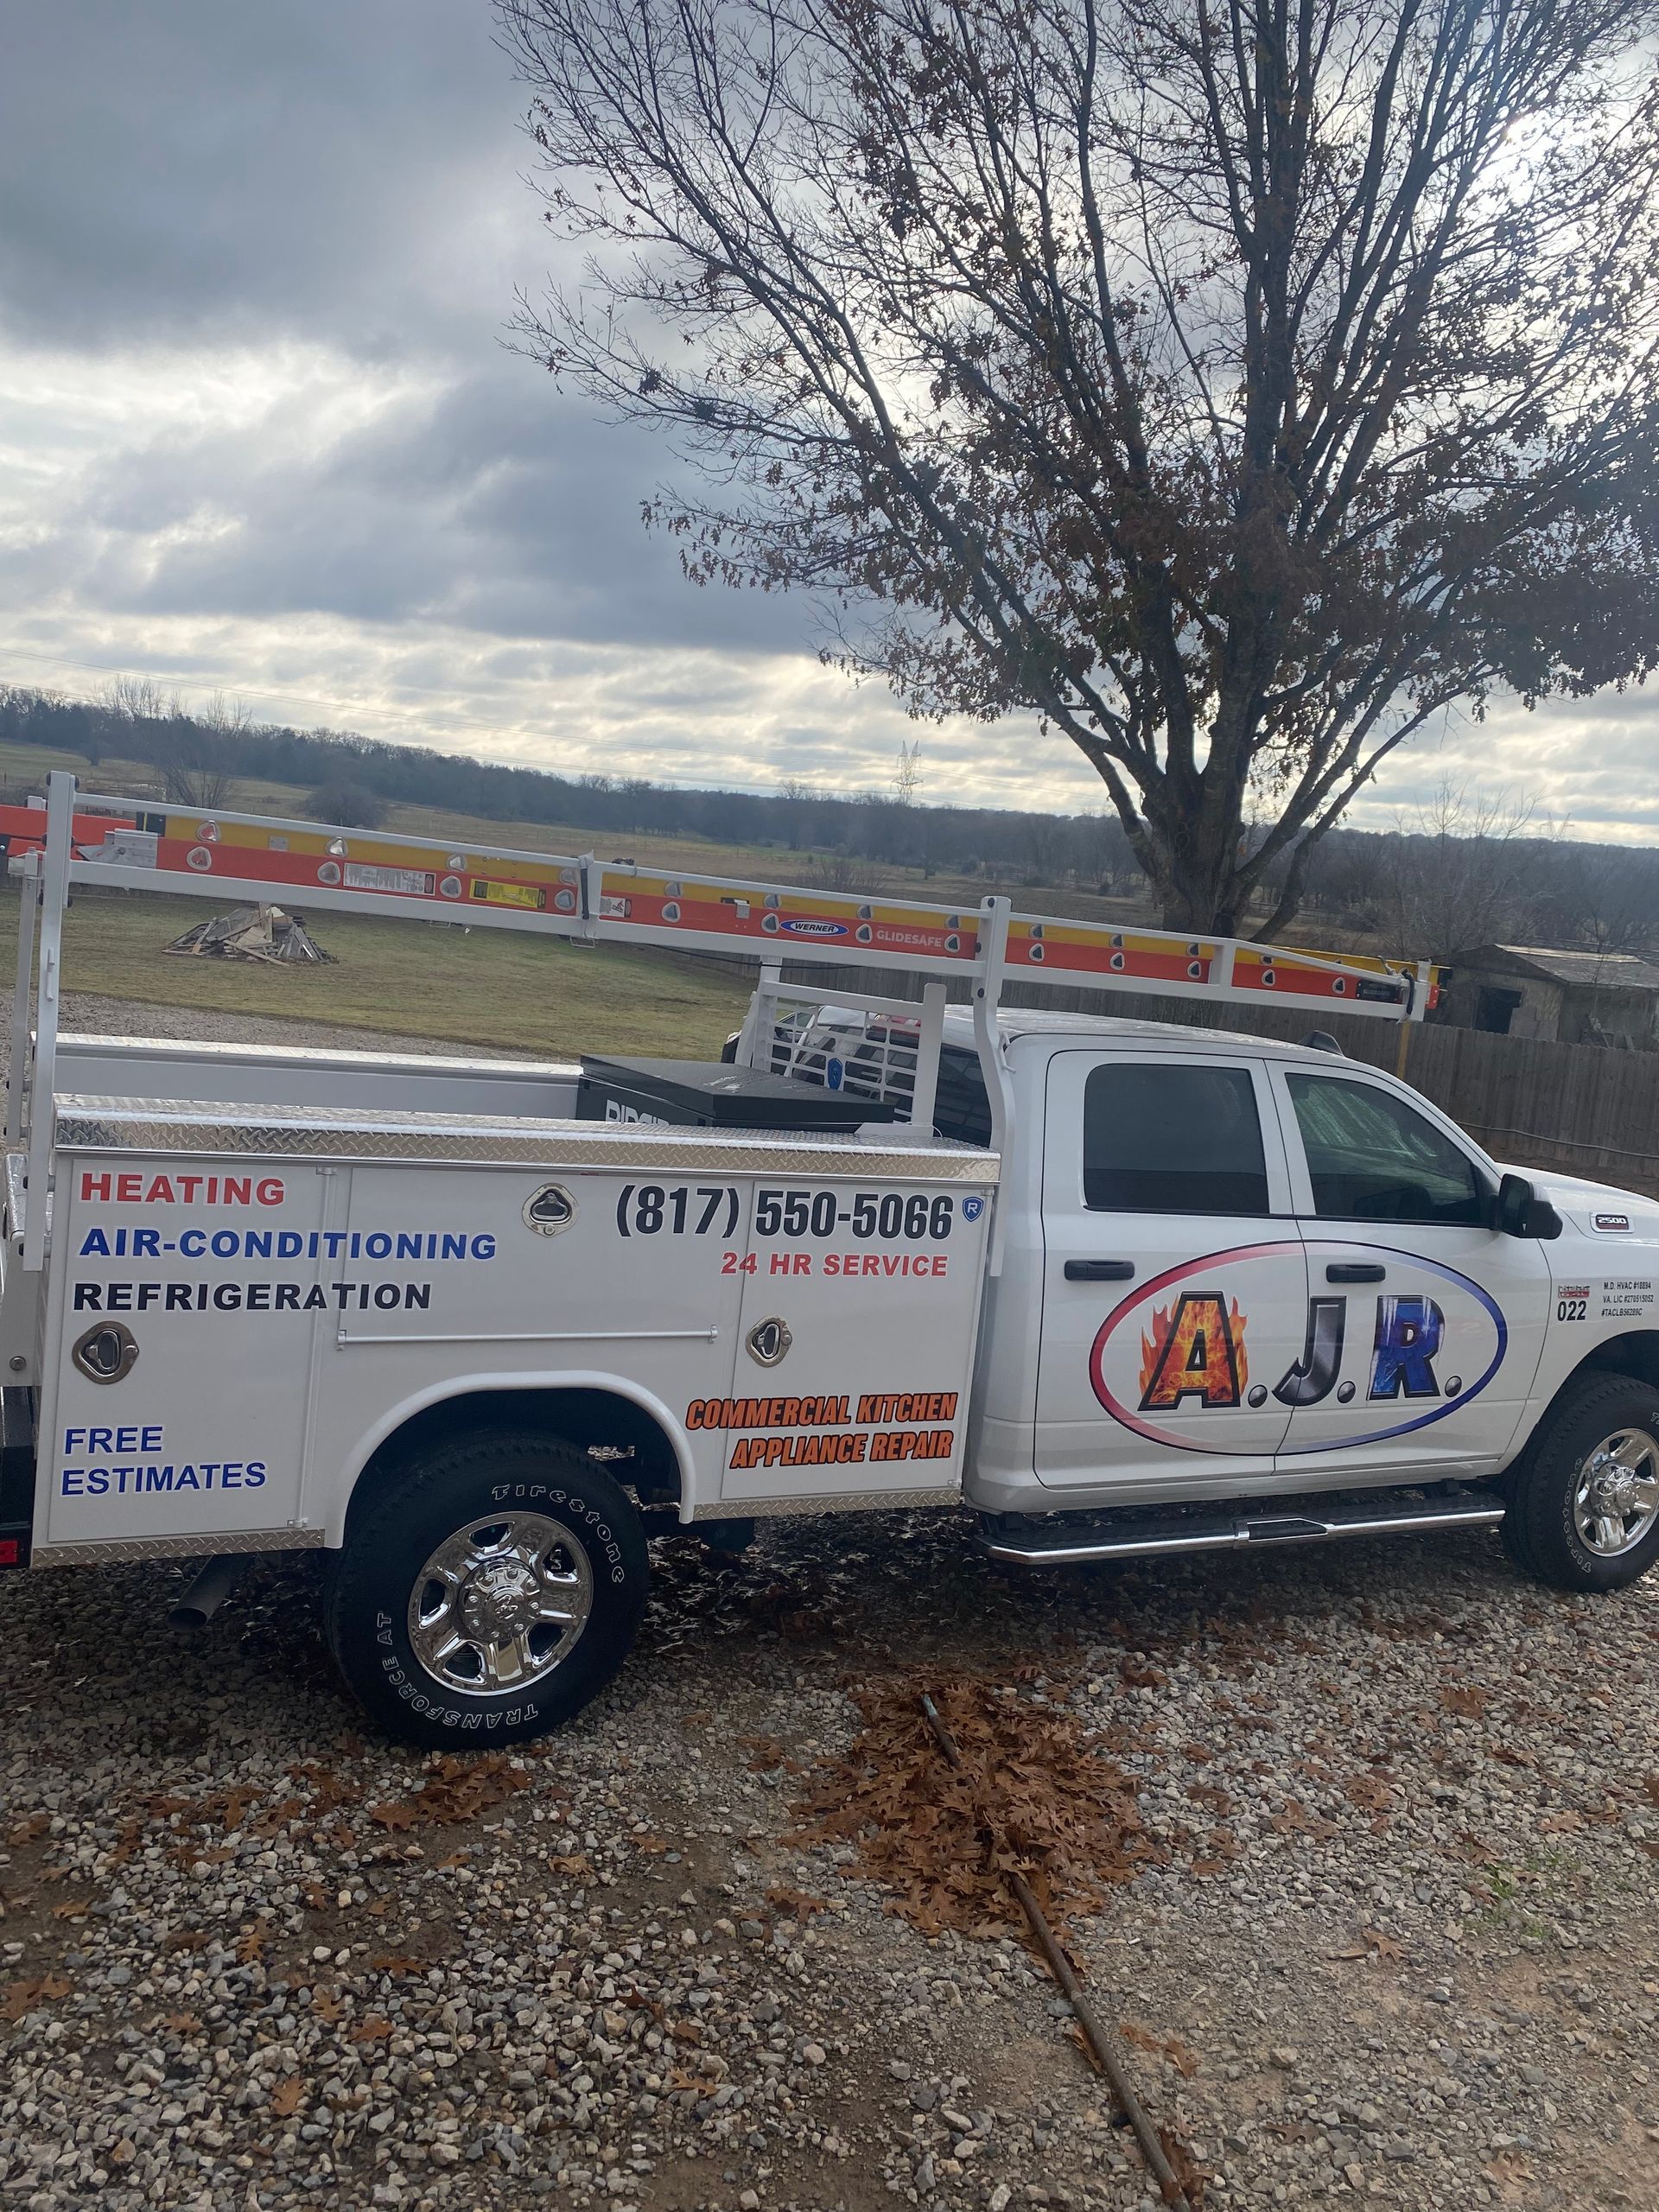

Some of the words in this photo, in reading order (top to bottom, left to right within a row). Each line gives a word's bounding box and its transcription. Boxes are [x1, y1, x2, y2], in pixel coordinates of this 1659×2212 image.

[795, 923, 836, 933] WERNER
[876, 930, 942, 947] GLIDESAFE
[81, 1173, 284, 1205] HEATING
[616, 1185, 739, 1238] (817)
[755, 1191, 953, 1239] 550-5066
[79, 1229, 496, 1260] AIR-CONDITIONING
[721, 1252, 757, 1275] 24
[770, 1253, 811, 1275] HR
[823, 1255, 948, 1277] SERVICE
[73, 1283, 431, 1310] REFRIGERATION
[1618, 1281, 1632, 1290] HVAC
[1558, 1300, 1586, 1321] 022
[1137, 1291, 1462, 1411] A.J.R.
[685, 1395, 851, 1430] COMMERCIAL
[855, 1393, 958, 1424] KITCHEN
[65, 1427, 162, 1455] FREE
[729, 1433, 868, 1469] APPLIANCE
[869, 1430, 954, 1462] REPAIR
[61, 1462, 266, 1496] ESTIMATES
[492, 1484, 625, 1583] Firestone
[377, 1612, 393, 1646] AT
[382, 1656, 538, 1729] TRANSFORCE
